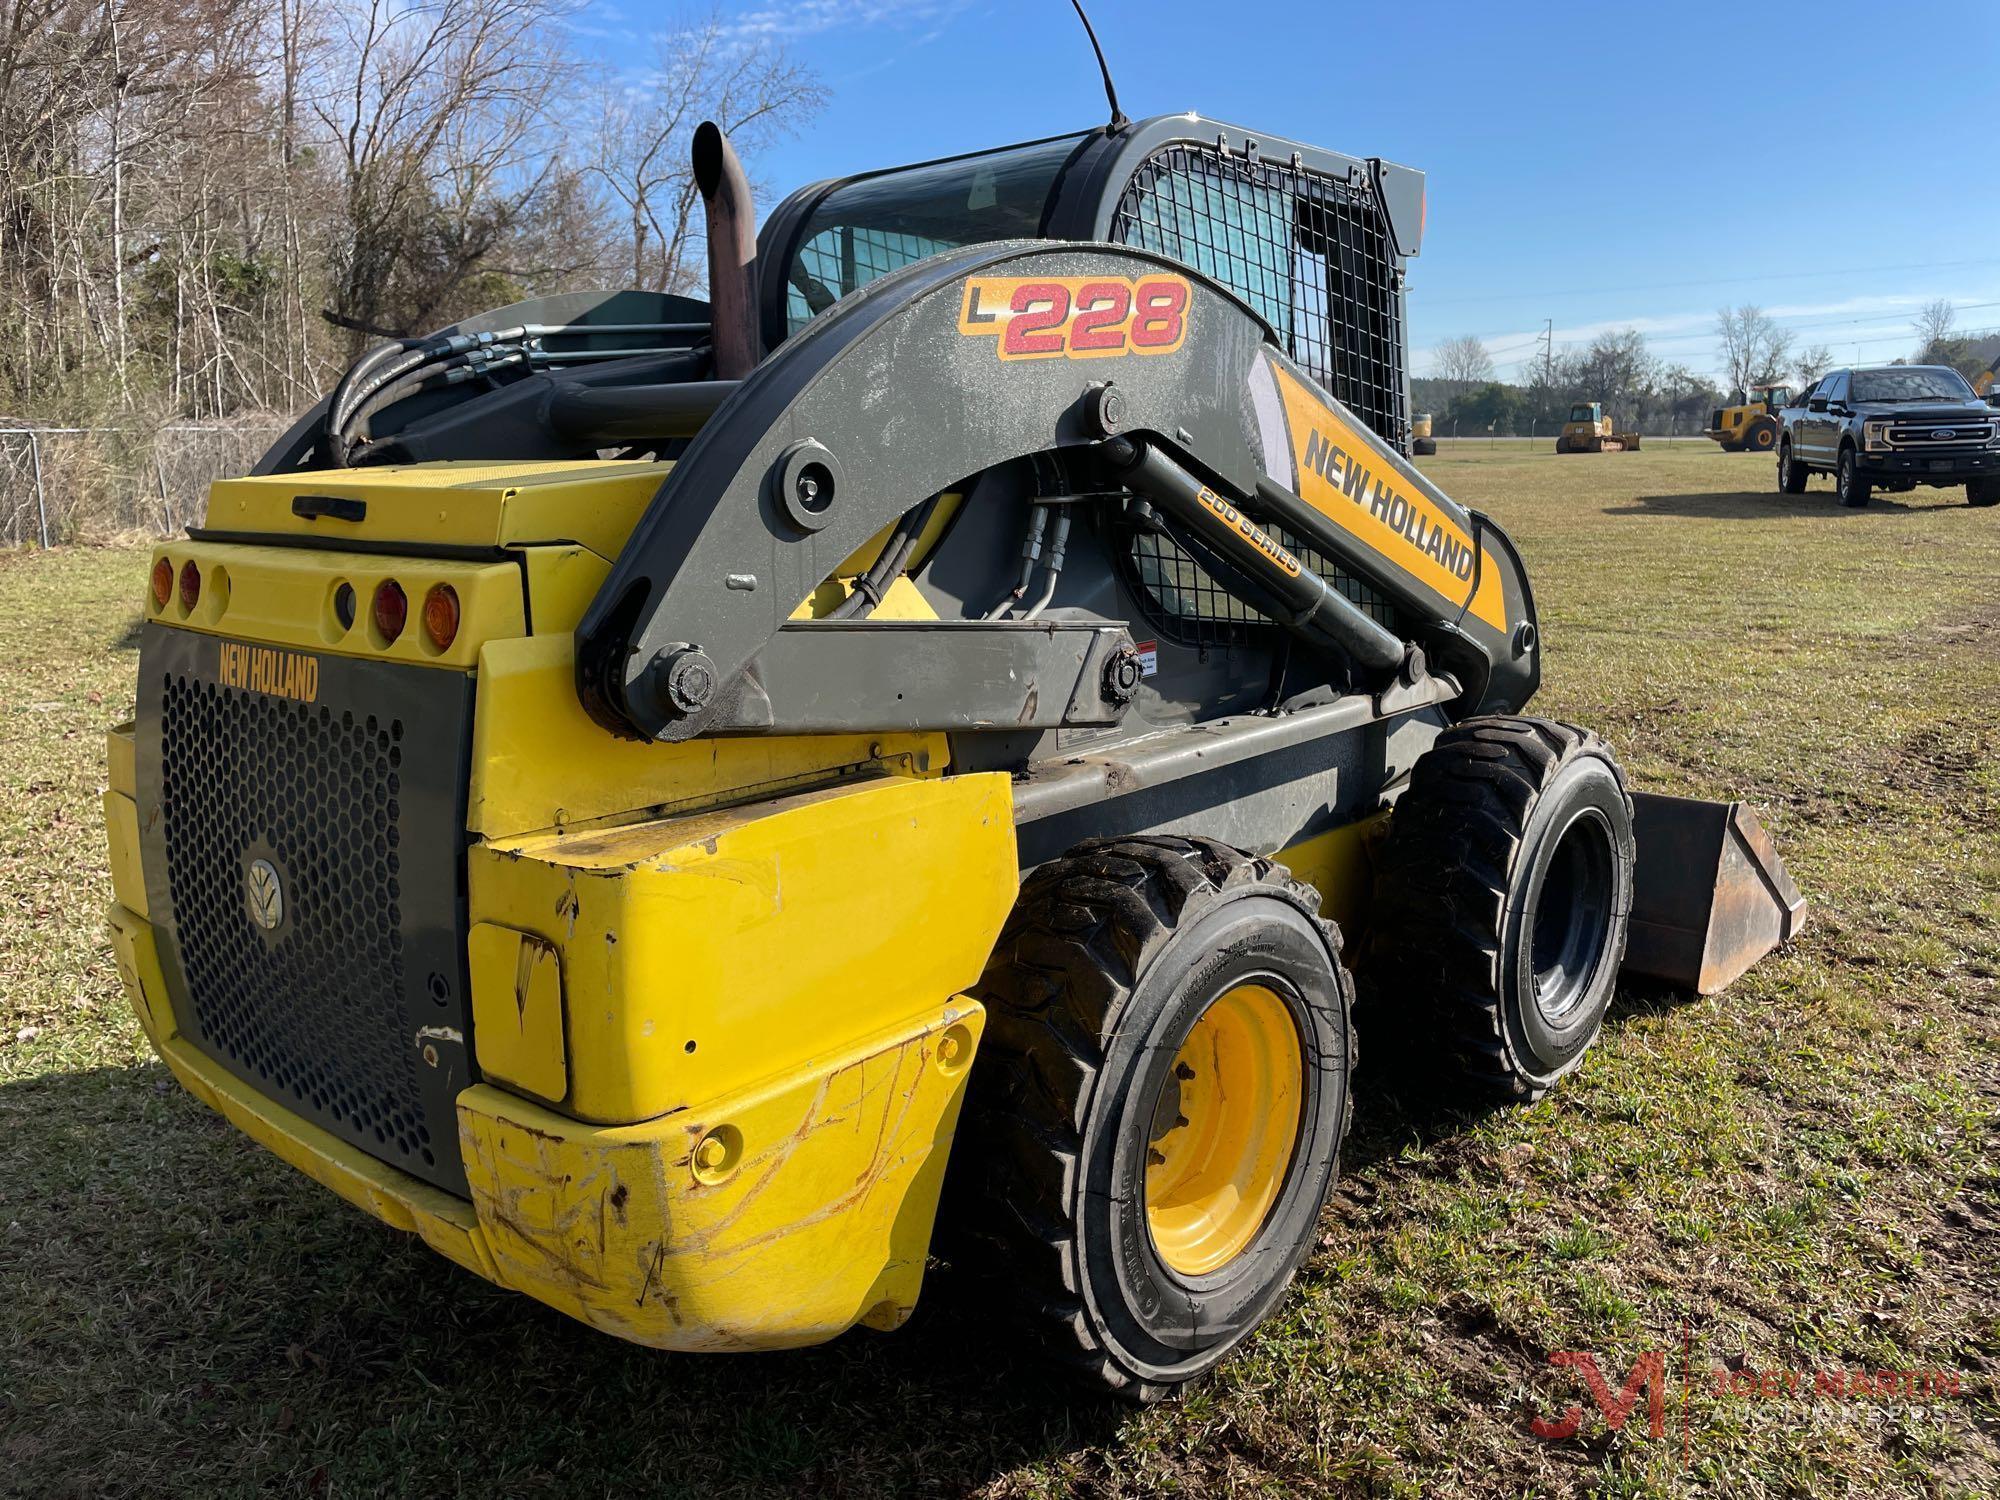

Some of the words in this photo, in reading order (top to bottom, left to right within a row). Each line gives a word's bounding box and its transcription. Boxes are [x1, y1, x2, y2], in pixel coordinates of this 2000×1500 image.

[966, 282, 1188, 355] L228
[1199, 488, 1238, 523] 200
[1239, 519, 1298, 573] SERIES
[1303, 428, 1371, 505] NEW
[1370, 479, 1474, 582] HOLLAND
[220, 643, 250, 688] NEW
[251, 648, 318, 702] HOLLAND
